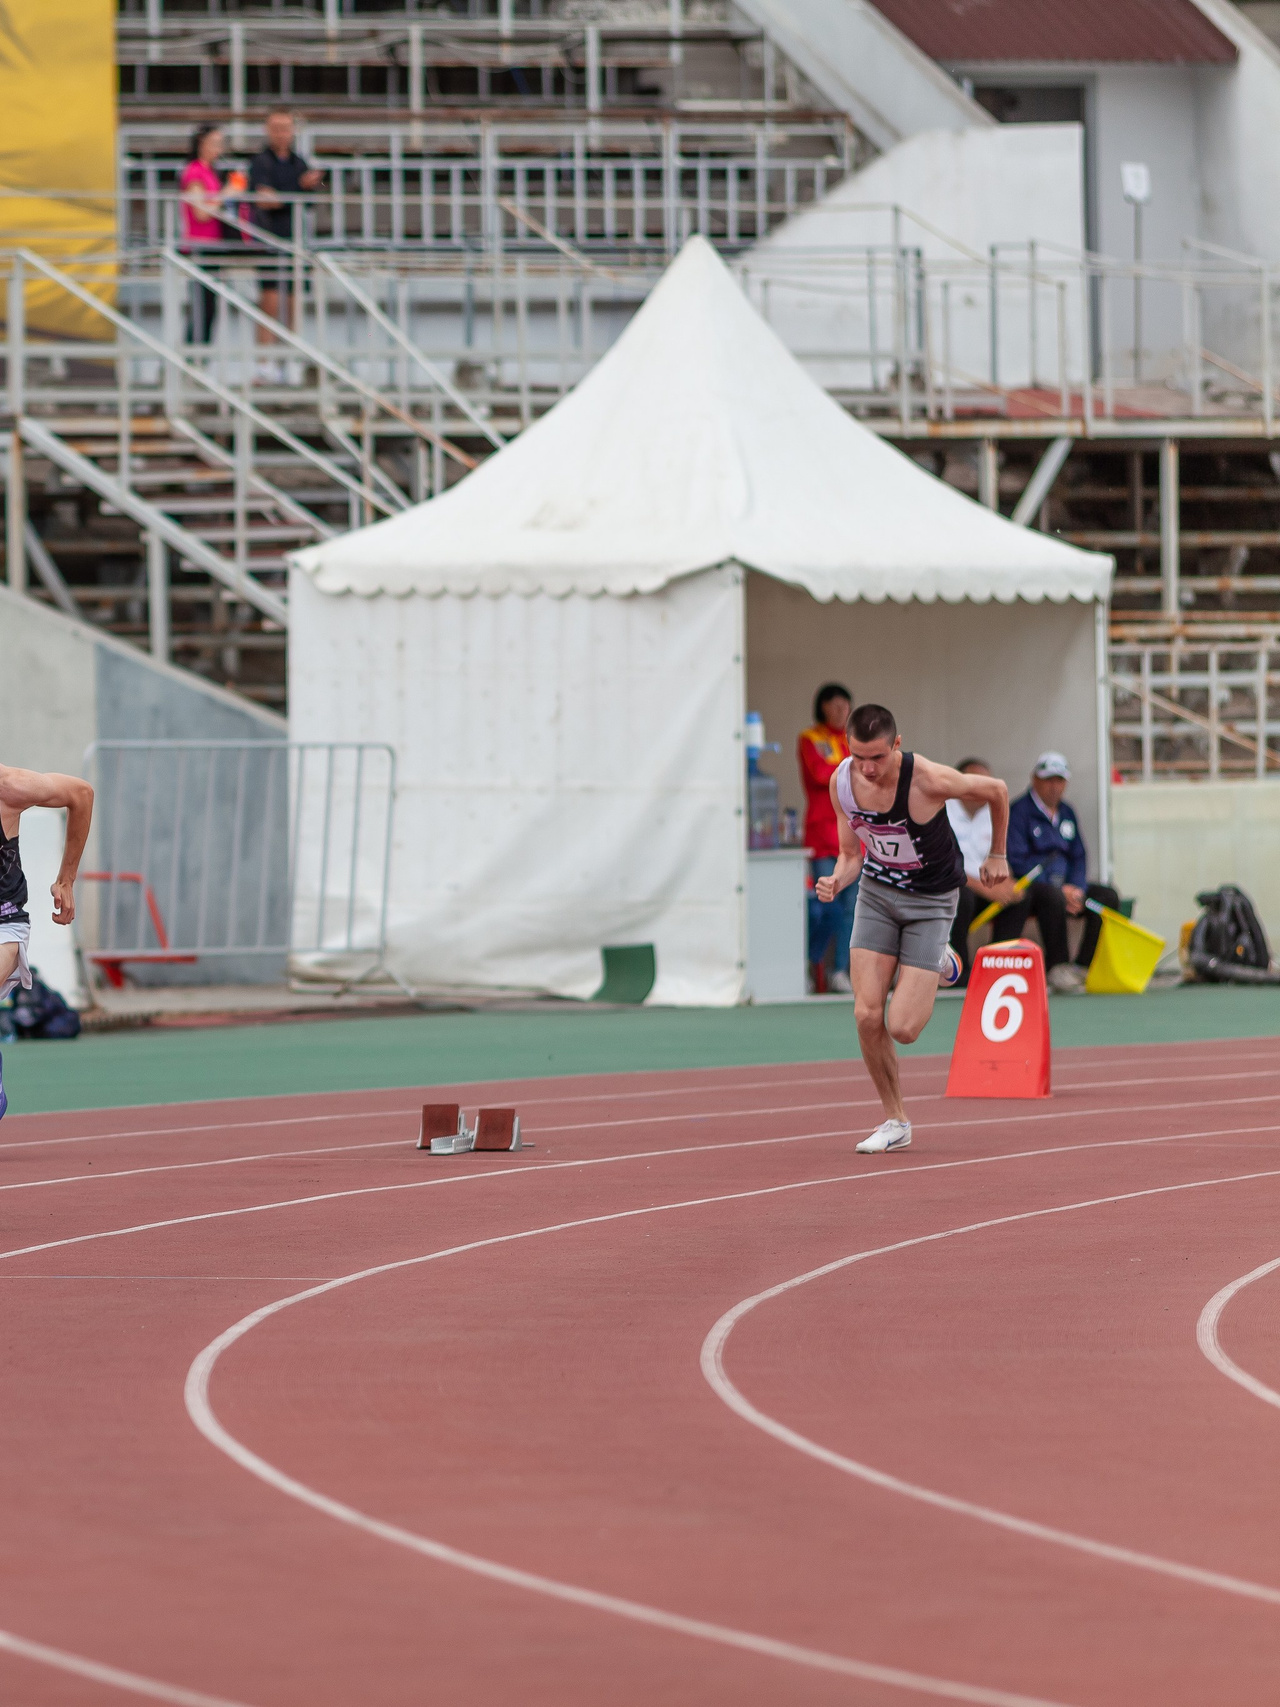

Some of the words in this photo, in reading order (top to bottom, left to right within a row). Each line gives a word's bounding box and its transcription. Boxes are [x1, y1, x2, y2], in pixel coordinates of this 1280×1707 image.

[869, 833, 900, 857] 117
[982, 956, 1034, 970] MONDO
[981, 973, 1029, 1043] 6
